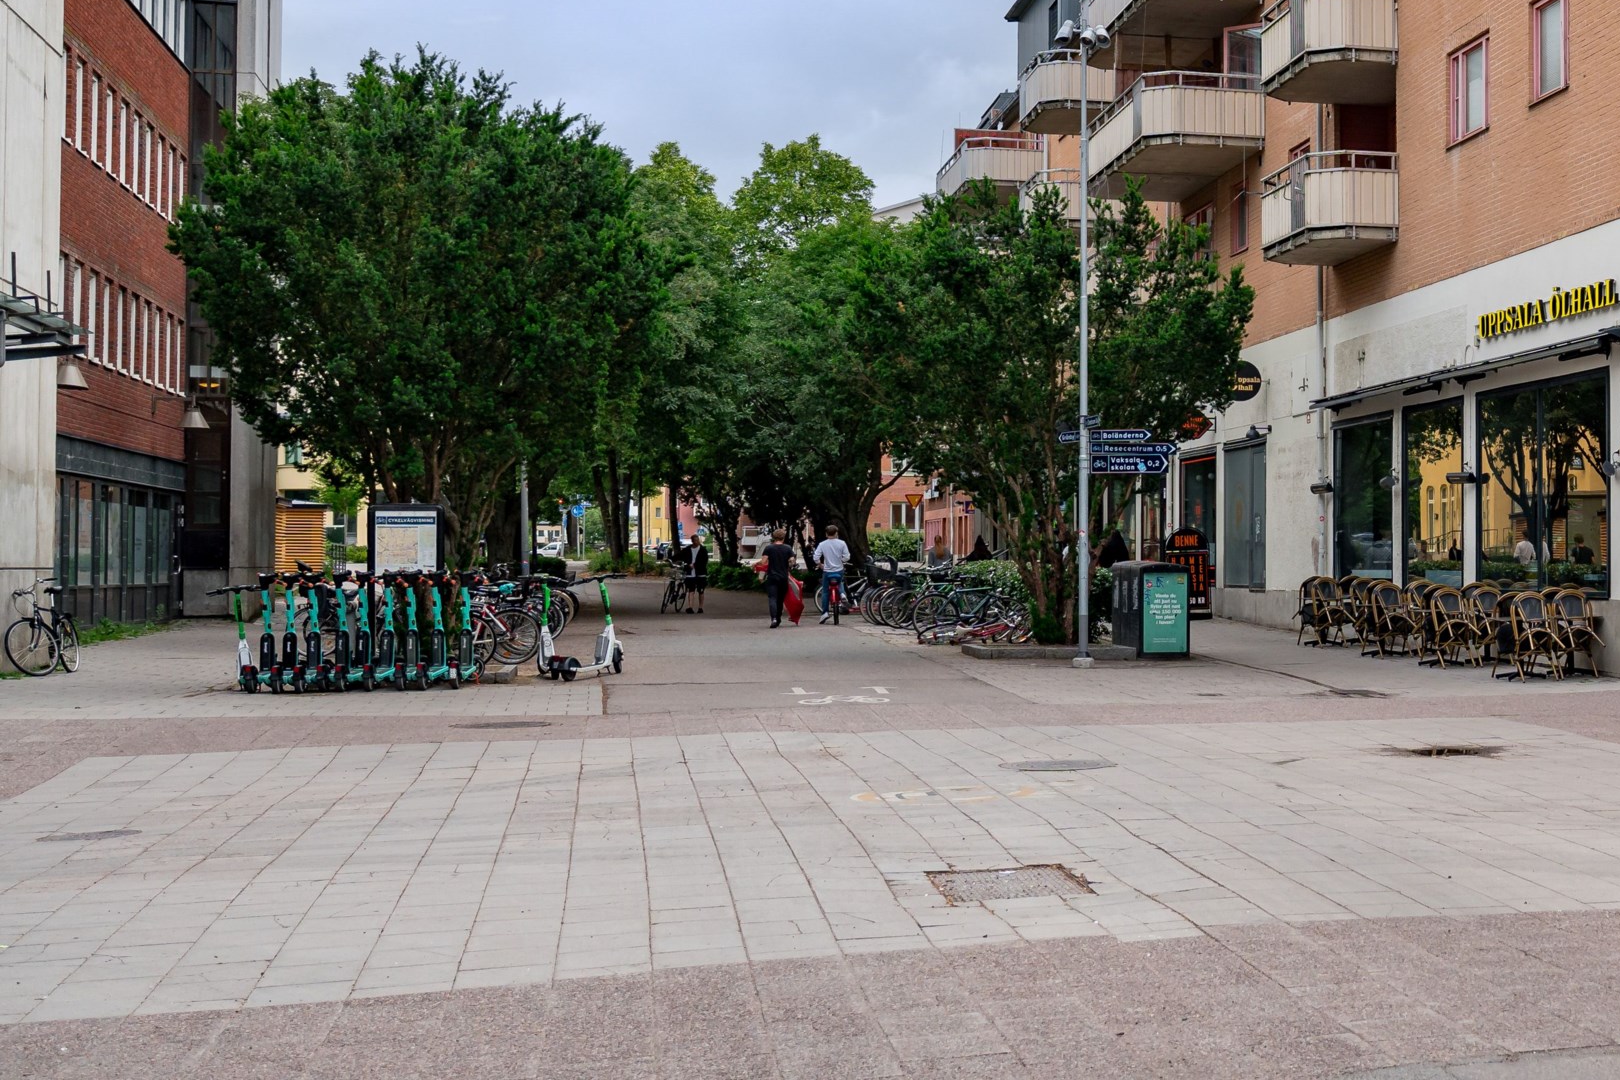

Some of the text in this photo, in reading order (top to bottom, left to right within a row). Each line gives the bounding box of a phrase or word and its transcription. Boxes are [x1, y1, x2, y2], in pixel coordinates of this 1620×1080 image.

[1478, 278, 1617, 339] UPPSALA ÖLHALL
[1174, 535, 1198, 547] BENNE
